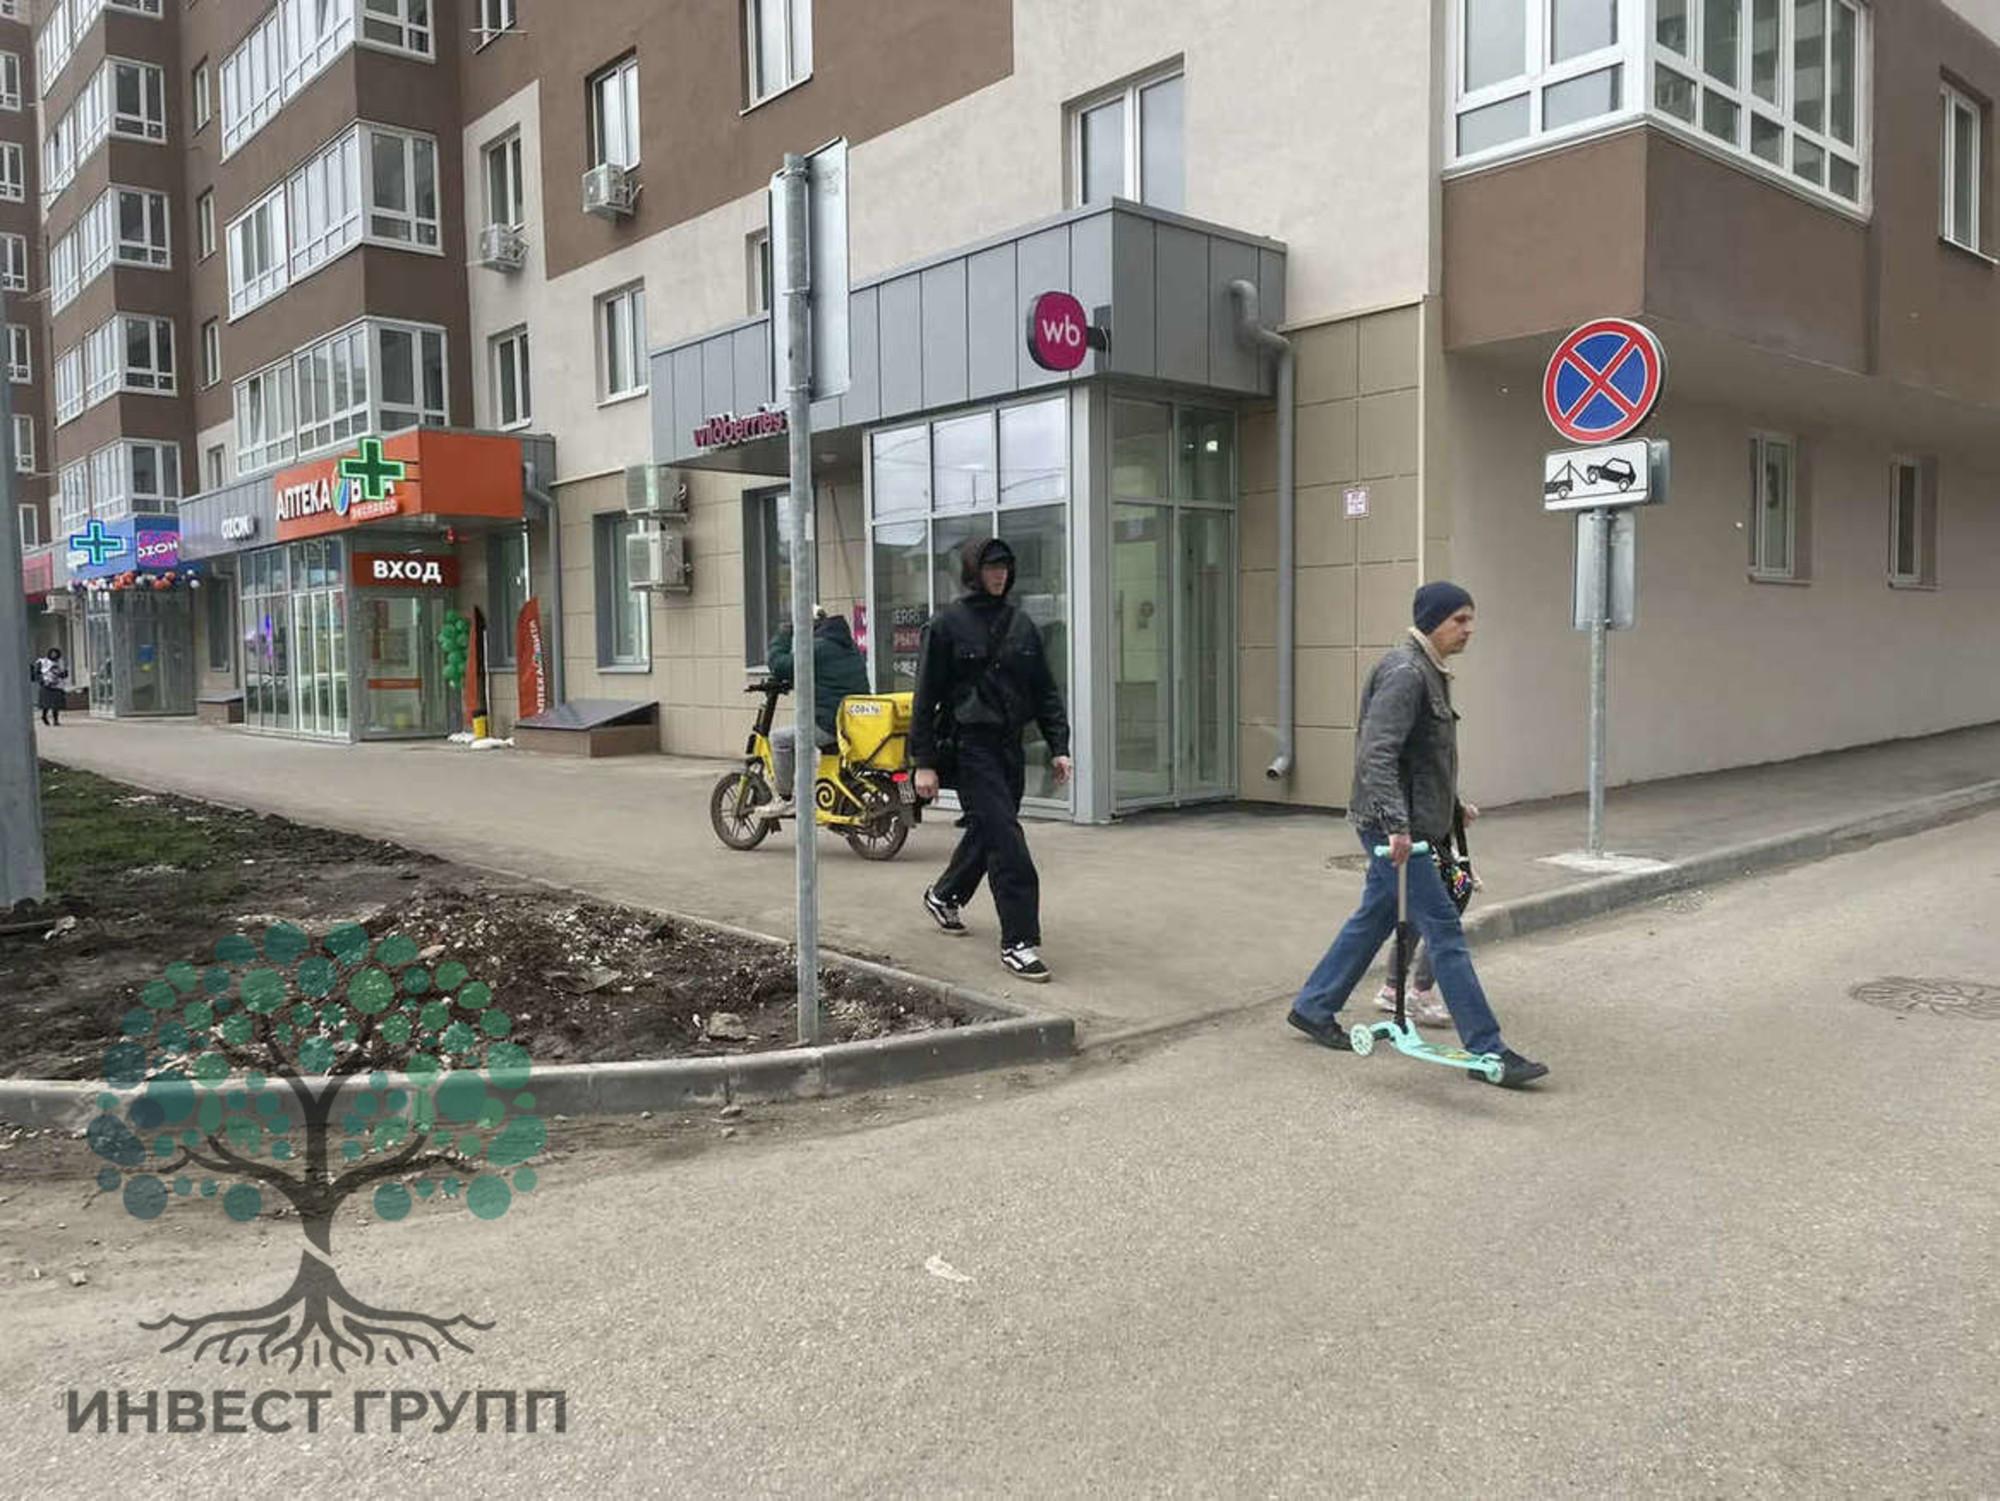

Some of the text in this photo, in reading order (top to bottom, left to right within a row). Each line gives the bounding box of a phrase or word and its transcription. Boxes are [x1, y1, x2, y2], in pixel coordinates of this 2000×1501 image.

[1042, 313, 1081, 346] wb
[693, 410, 784, 448] wildberries
[275, 477, 332, 521] АПТЕКА
[221, 515, 253, 539] OZON
[138, 539, 178, 557] OZON
[373, 560, 442, 584] ВХОД
